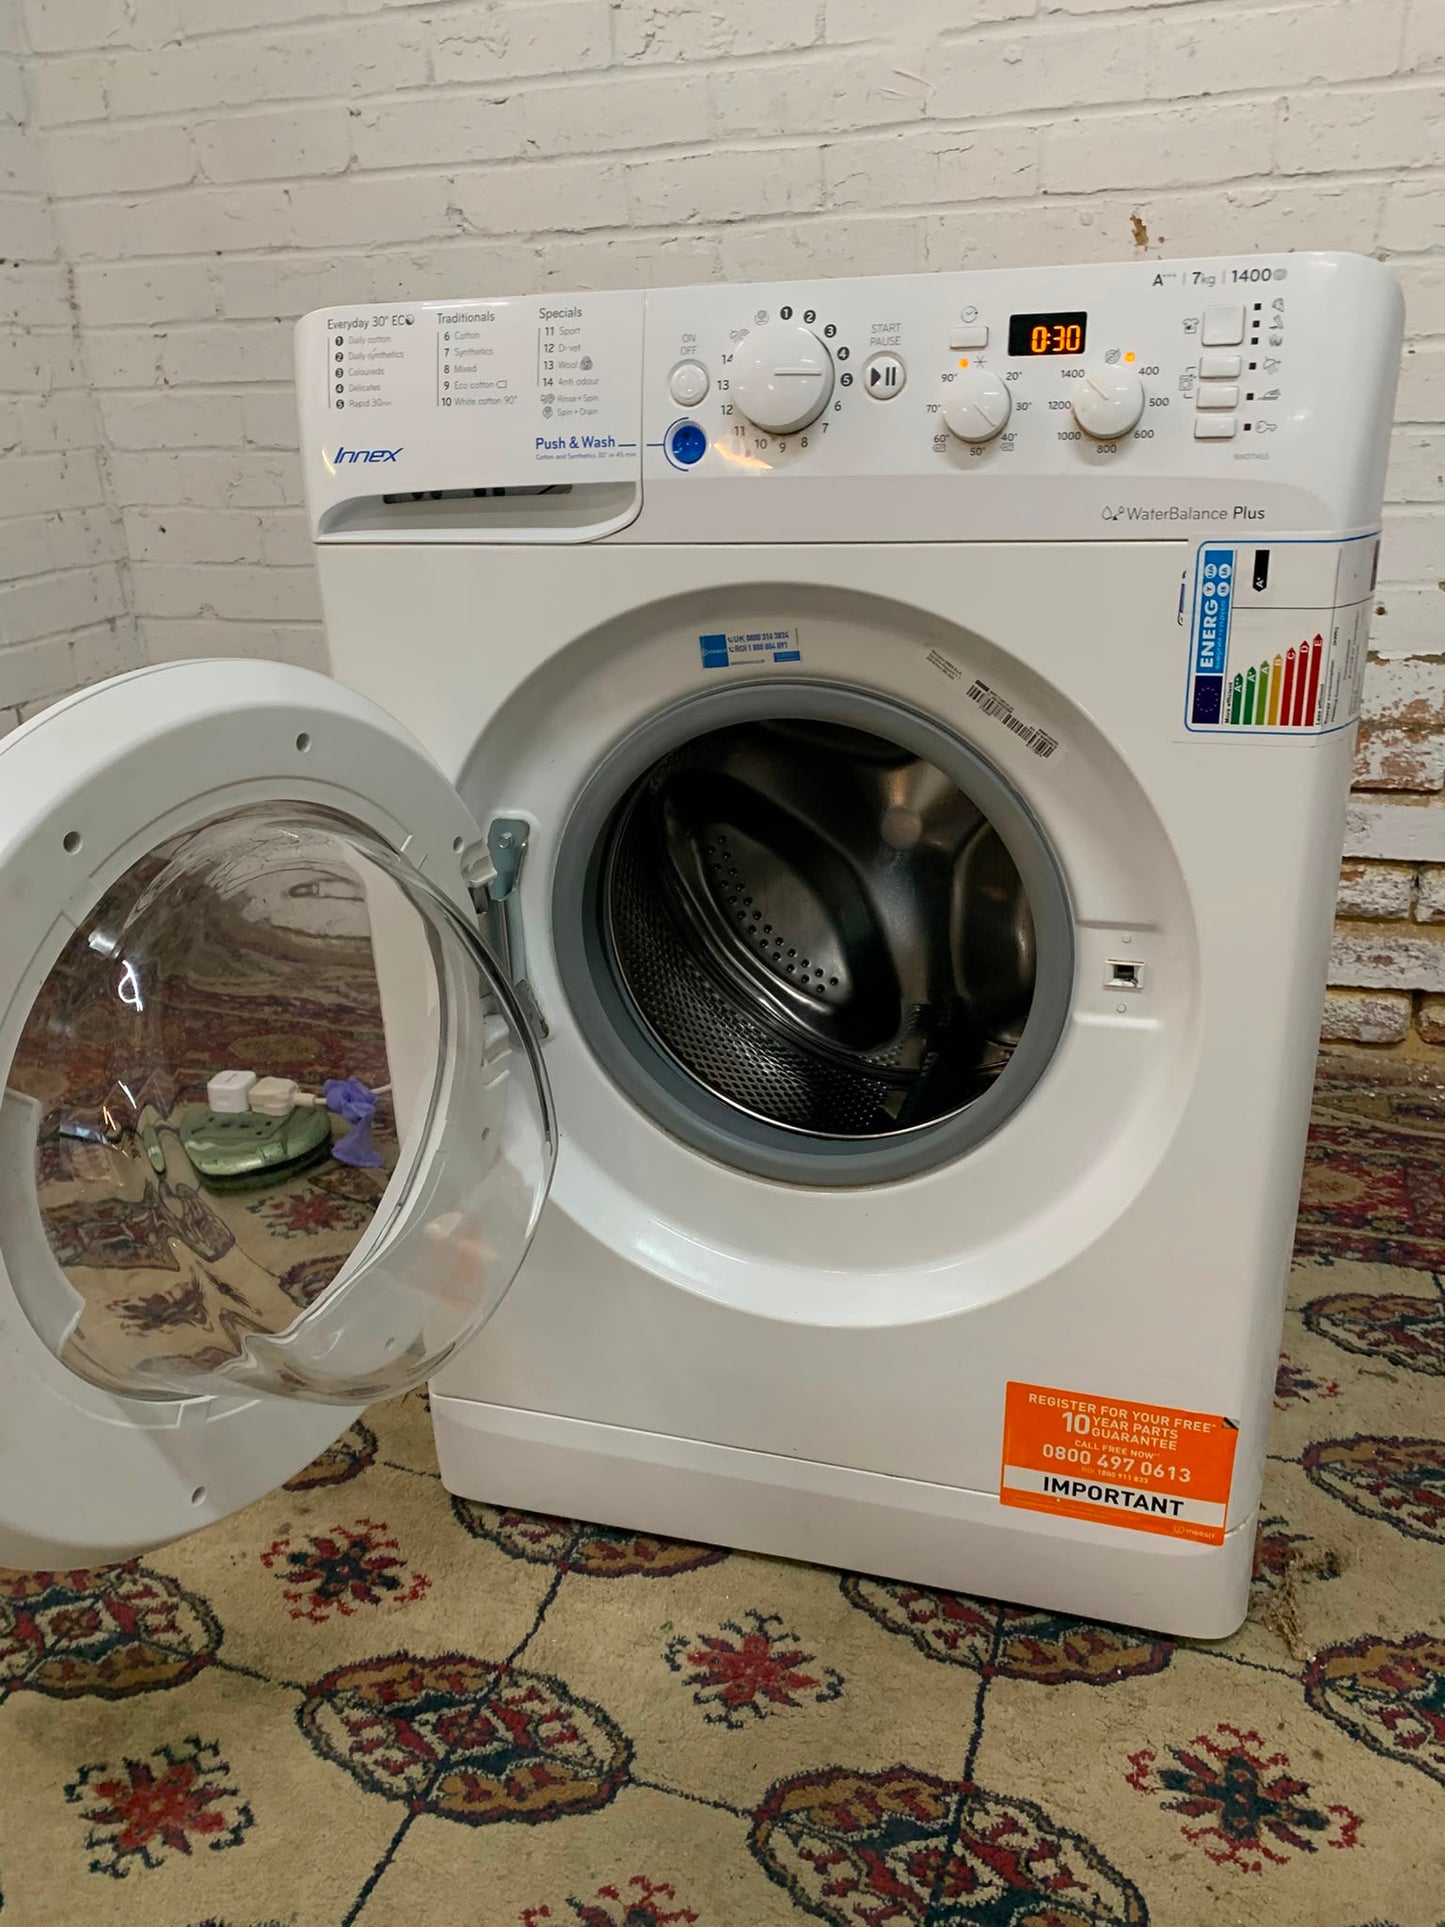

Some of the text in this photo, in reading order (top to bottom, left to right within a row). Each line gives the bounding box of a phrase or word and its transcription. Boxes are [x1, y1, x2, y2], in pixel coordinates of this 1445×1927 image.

[1192, 271, 1216, 287] 7kg
[1232, 268, 1272, 282] 1400
[437, 310, 496, 324] Traditionals
[539, 307, 582, 320] Specials
[328, 318, 369, 330] Everyday
[871, 323, 901, 334] START
[444, 331, 480, 341] 6 Cotton
[545, 327, 581, 336] 11 Sport
[367, 336, 391, 344] cotton
[681, 333, 696, 343] ON
[870, 336, 901, 346] PAUSE
[1031, 324, 1081, 353] 0:30
[444, 348, 494, 358] 7 Synthetics
[544, 343, 555, 353] 12
[680, 345, 698, 355] OFF
[722, 354, 733, 364] 14
[444, 365, 477, 374] 8 Mixed
[544, 361, 578, 370] 13 Wool
[1061, 369, 1085, 378] 1400
[1138, 366, 1160, 376] 400
[444, 381, 494, 391] 9 Eco cotton
[543, 378, 553, 386] 14
[576, 377, 599, 385] odour
[717, 380, 730, 390] 13
[348, 399, 370, 408] Rapid
[442, 397, 452, 407] 10
[834, 401, 842, 411] 6
[1048, 400, 1072, 409] 1200
[1149, 397, 1170, 407] 500
[721, 405, 733, 415] 12
[734, 426, 745, 436] 11
[822, 423, 829, 433] 7
[1058, 431, 1081, 441] 1000
[1134, 429, 1155, 439] 600
[535, 436, 615, 449] Push & Wash
[755, 439, 768, 449] 10
[779, 442, 786, 453] 9
[801, 437, 808, 448] 8
[1097, 445, 1117, 454] 800
[334, 447, 403, 464] Innex
[1127, 506, 1265, 521] WaterBalance Plus
[1200, 599, 1218, 667] ENERG
[1300, 645, 1308, 653] D
[1029, 1393, 1097, 1413] REGISTER
[1101, 1405, 1128, 1419] FOR
[1132, 1411, 1170, 1428] YOUR
[1063, 1411, 1179, 1439] 10 YEAR PARTS
[1091, 1427, 1177, 1451] GUARANTEE
[1075, 1439, 1099, 1450] CALL
[1102, 1444, 1127, 1456] FREE
[1042, 1443, 1191, 1483] 0800 497 0613
[1097, 1469, 1116, 1478] 1800
[1117, 1472, 1132, 1481] 911
[1043, 1476, 1184, 1515] IMPORTANT
